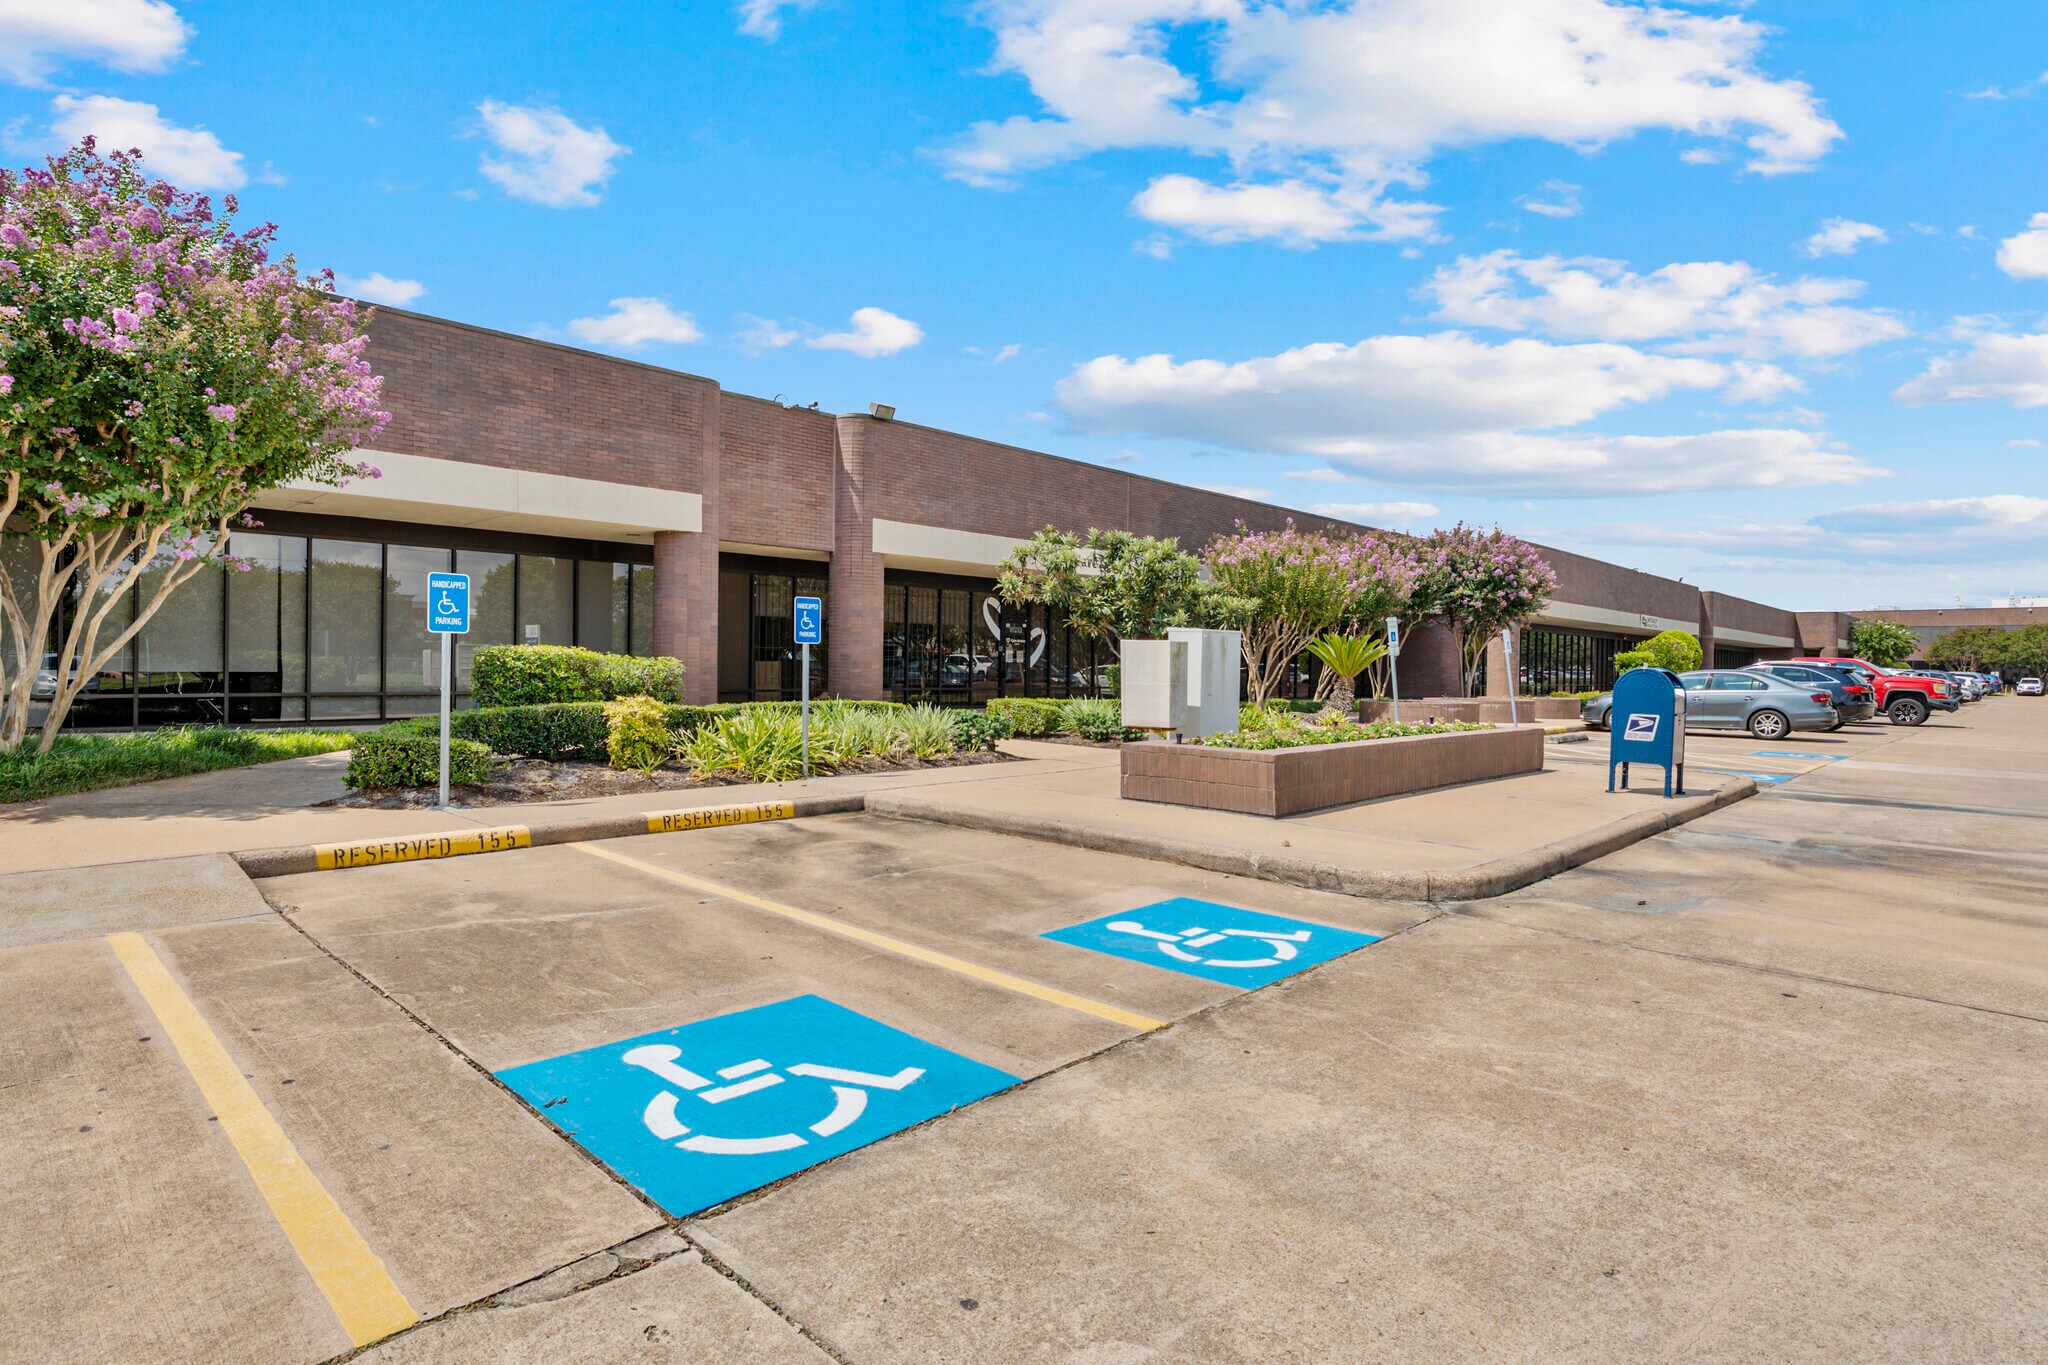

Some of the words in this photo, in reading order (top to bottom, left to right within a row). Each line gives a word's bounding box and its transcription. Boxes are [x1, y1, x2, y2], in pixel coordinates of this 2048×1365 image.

[431, 580, 467, 590] HANDICAPPED
[435, 616, 462, 626] PARKING
[663, 808, 742, 830] RESERVED
[756, 803, 783, 820] 155
[334, 837, 452, 868] RESERVED
[478, 830, 517, 850] 155
